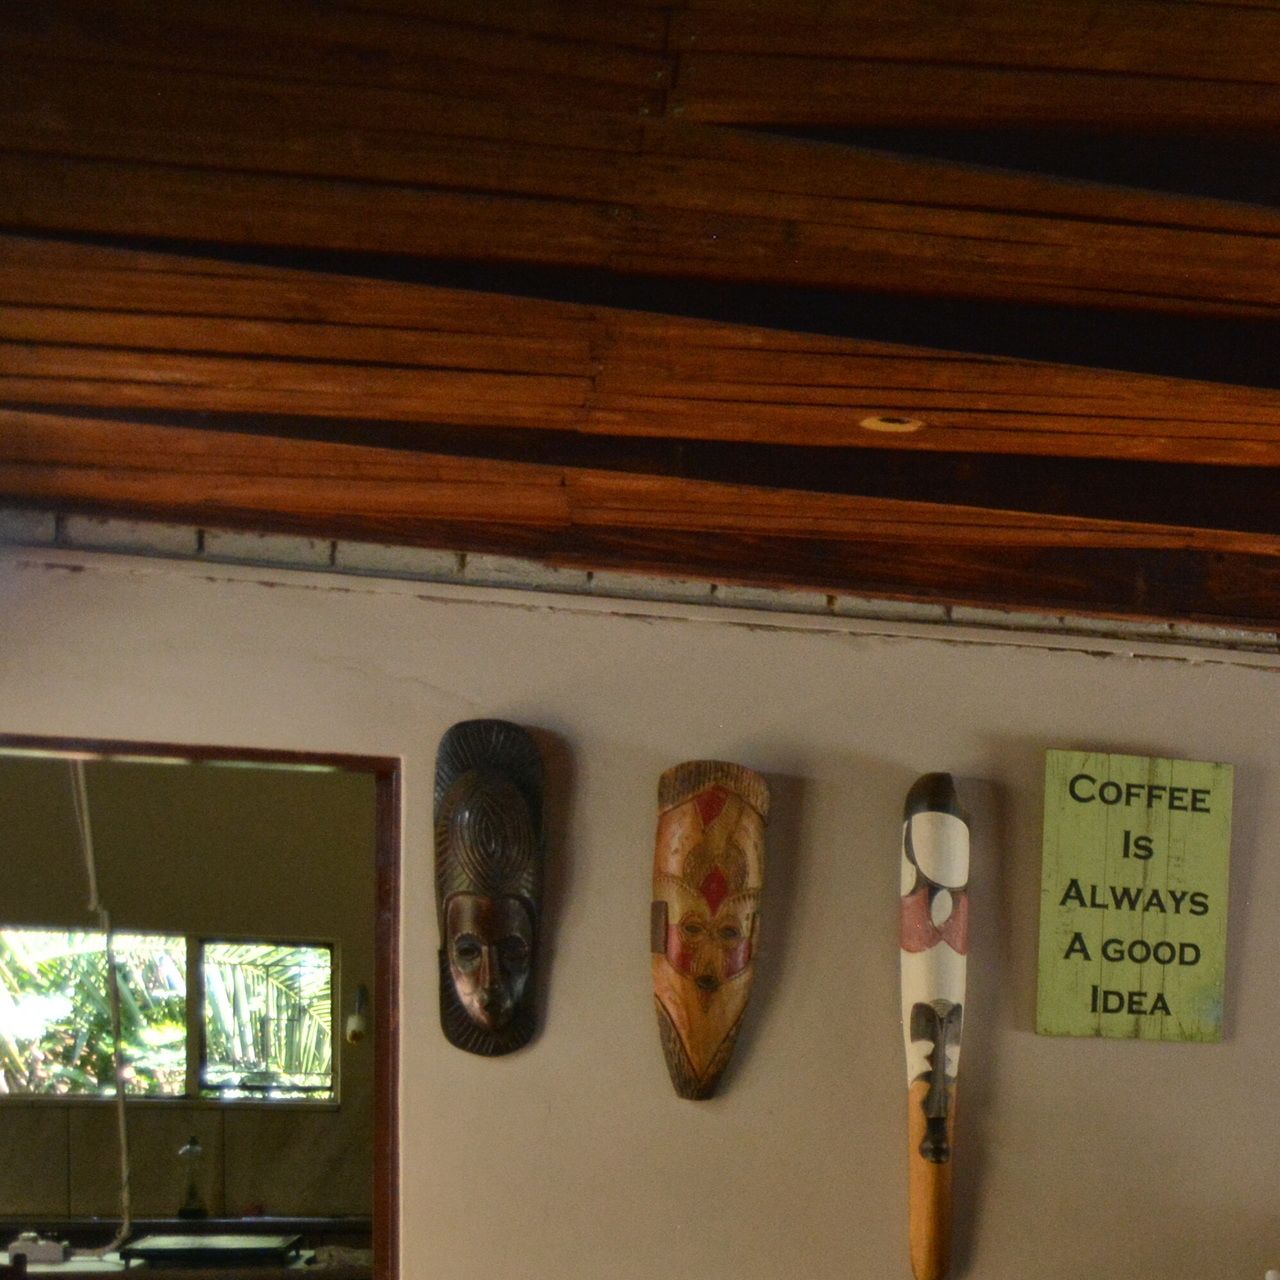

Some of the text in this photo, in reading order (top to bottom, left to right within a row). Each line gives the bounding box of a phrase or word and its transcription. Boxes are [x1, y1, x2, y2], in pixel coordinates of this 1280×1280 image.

[1068, 774, 1211, 814] COFFEE
[1122, 830, 1154, 860] IS
[1059, 878, 1209, 916] ALWAYS
[1063, 932, 1201, 965] A GOOD
[1090, 985, 1171, 1016] IDEA
